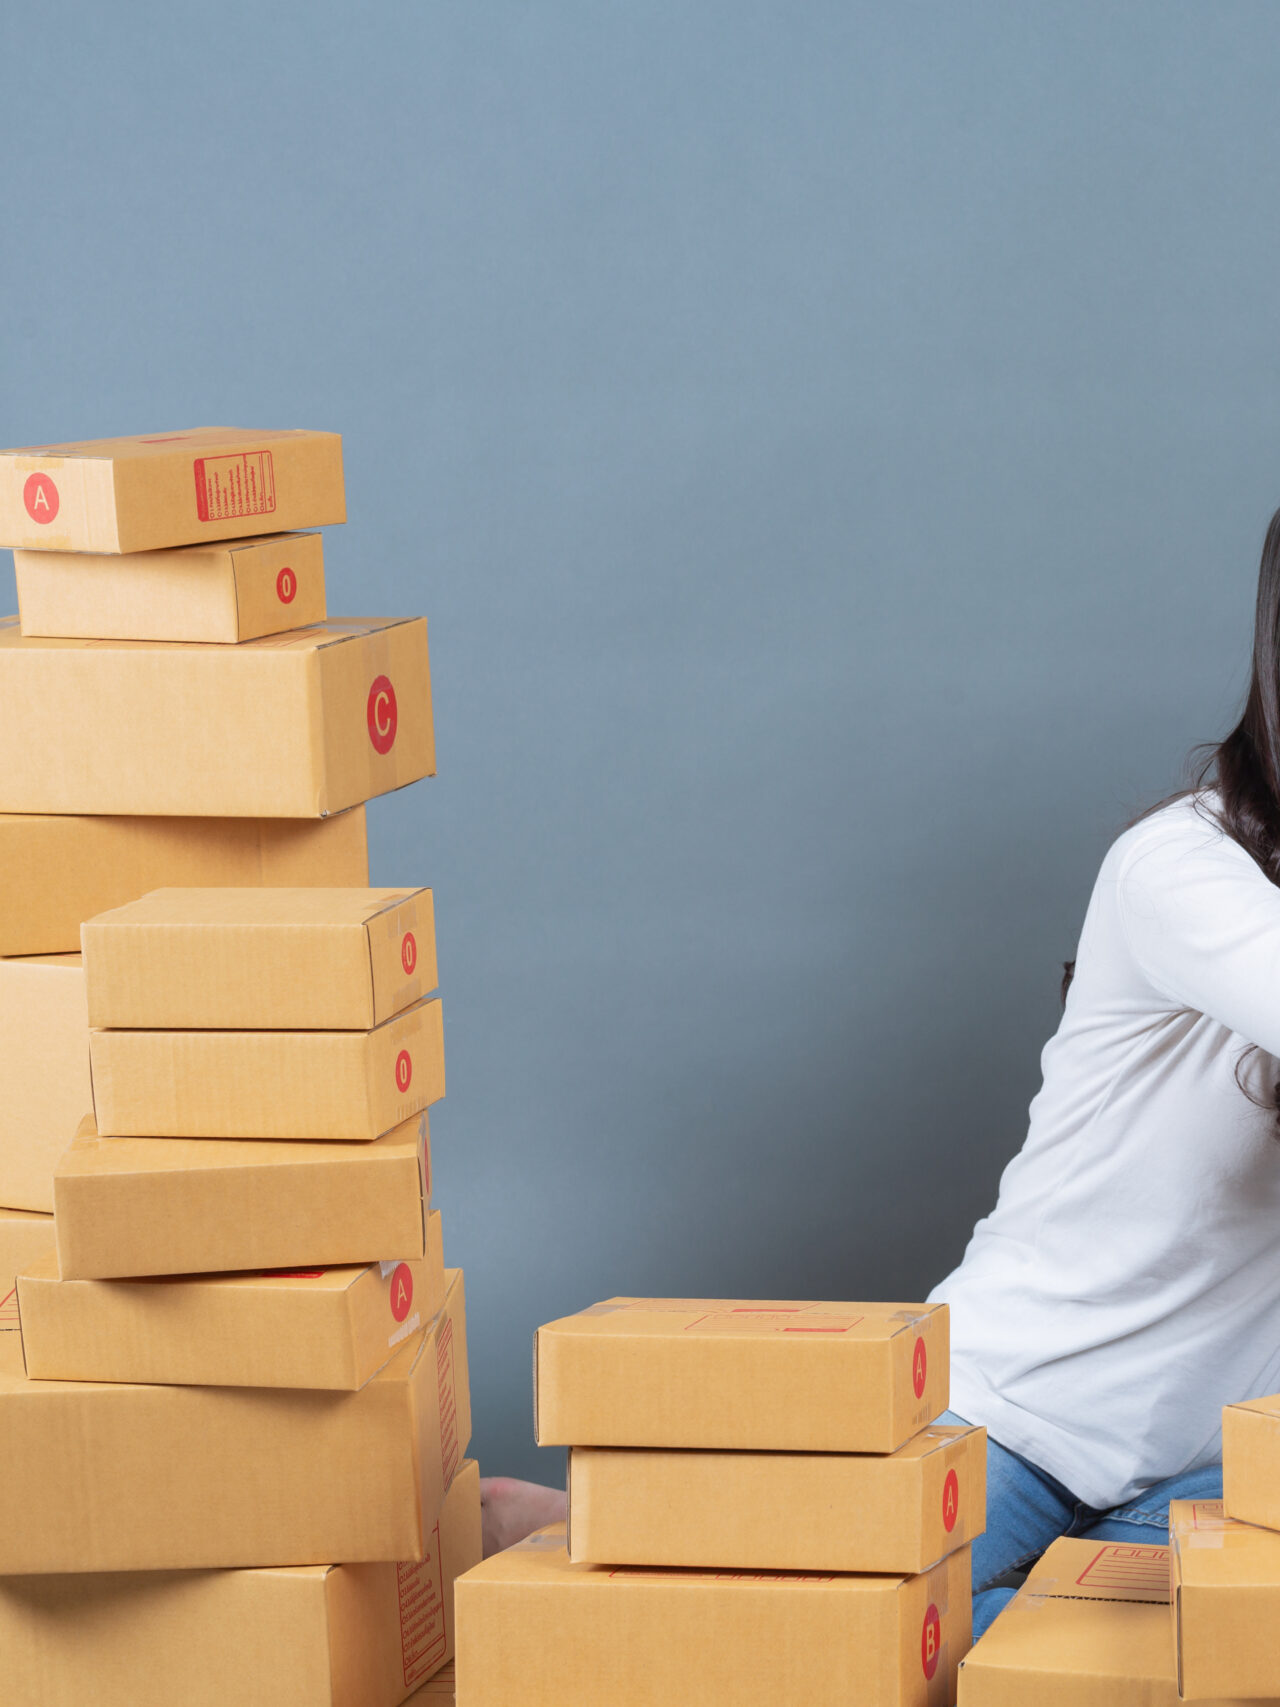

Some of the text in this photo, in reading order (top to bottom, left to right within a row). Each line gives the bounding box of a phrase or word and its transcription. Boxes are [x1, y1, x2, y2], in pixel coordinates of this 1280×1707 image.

[34, 485, 50, 511] A
[374, 690, 391, 737] C
[397, 1279, 408, 1308] A
[915, 1353, 924, 1382] A
[946, 1486, 955, 1516] A
[926, 1623, 937, 1664] B
